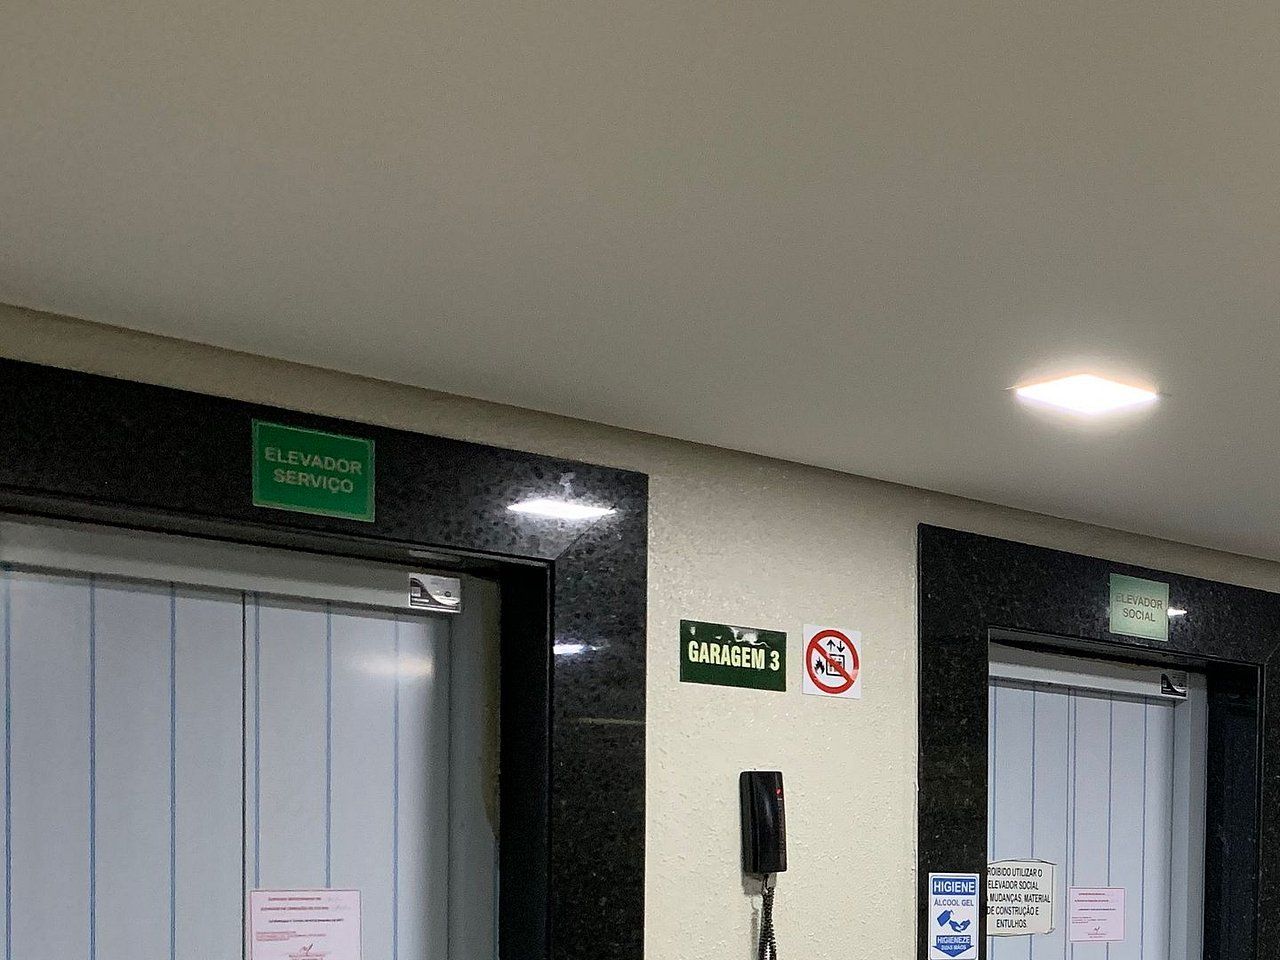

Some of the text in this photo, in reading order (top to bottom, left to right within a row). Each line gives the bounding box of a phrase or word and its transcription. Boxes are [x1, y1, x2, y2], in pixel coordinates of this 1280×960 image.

[264, 446, 362, 474] ELEVADOR
[273, 467, 354, 493] SERVIÇO
[1116, 592, 1163, 610] ELEVADOR
[1122, 607, 1156, 622] SOCIAL
[688, 640, 780, 671] GARAGEM 3
[987, 866, 1043, 877] ROIBIDO UTILIZAR O
[933, 881, 975, 893] HIGIENE
[988, 879, 1039, 890] ELEVADOR SOCIAL
[934, 898, 960, 906] ÁLCOOL
[1023, 893, 1050, 903] MATERIAL
[995, 904, 1034, 917] CONSTRUÇÃO
[1035, 906, 1039, 915] E
